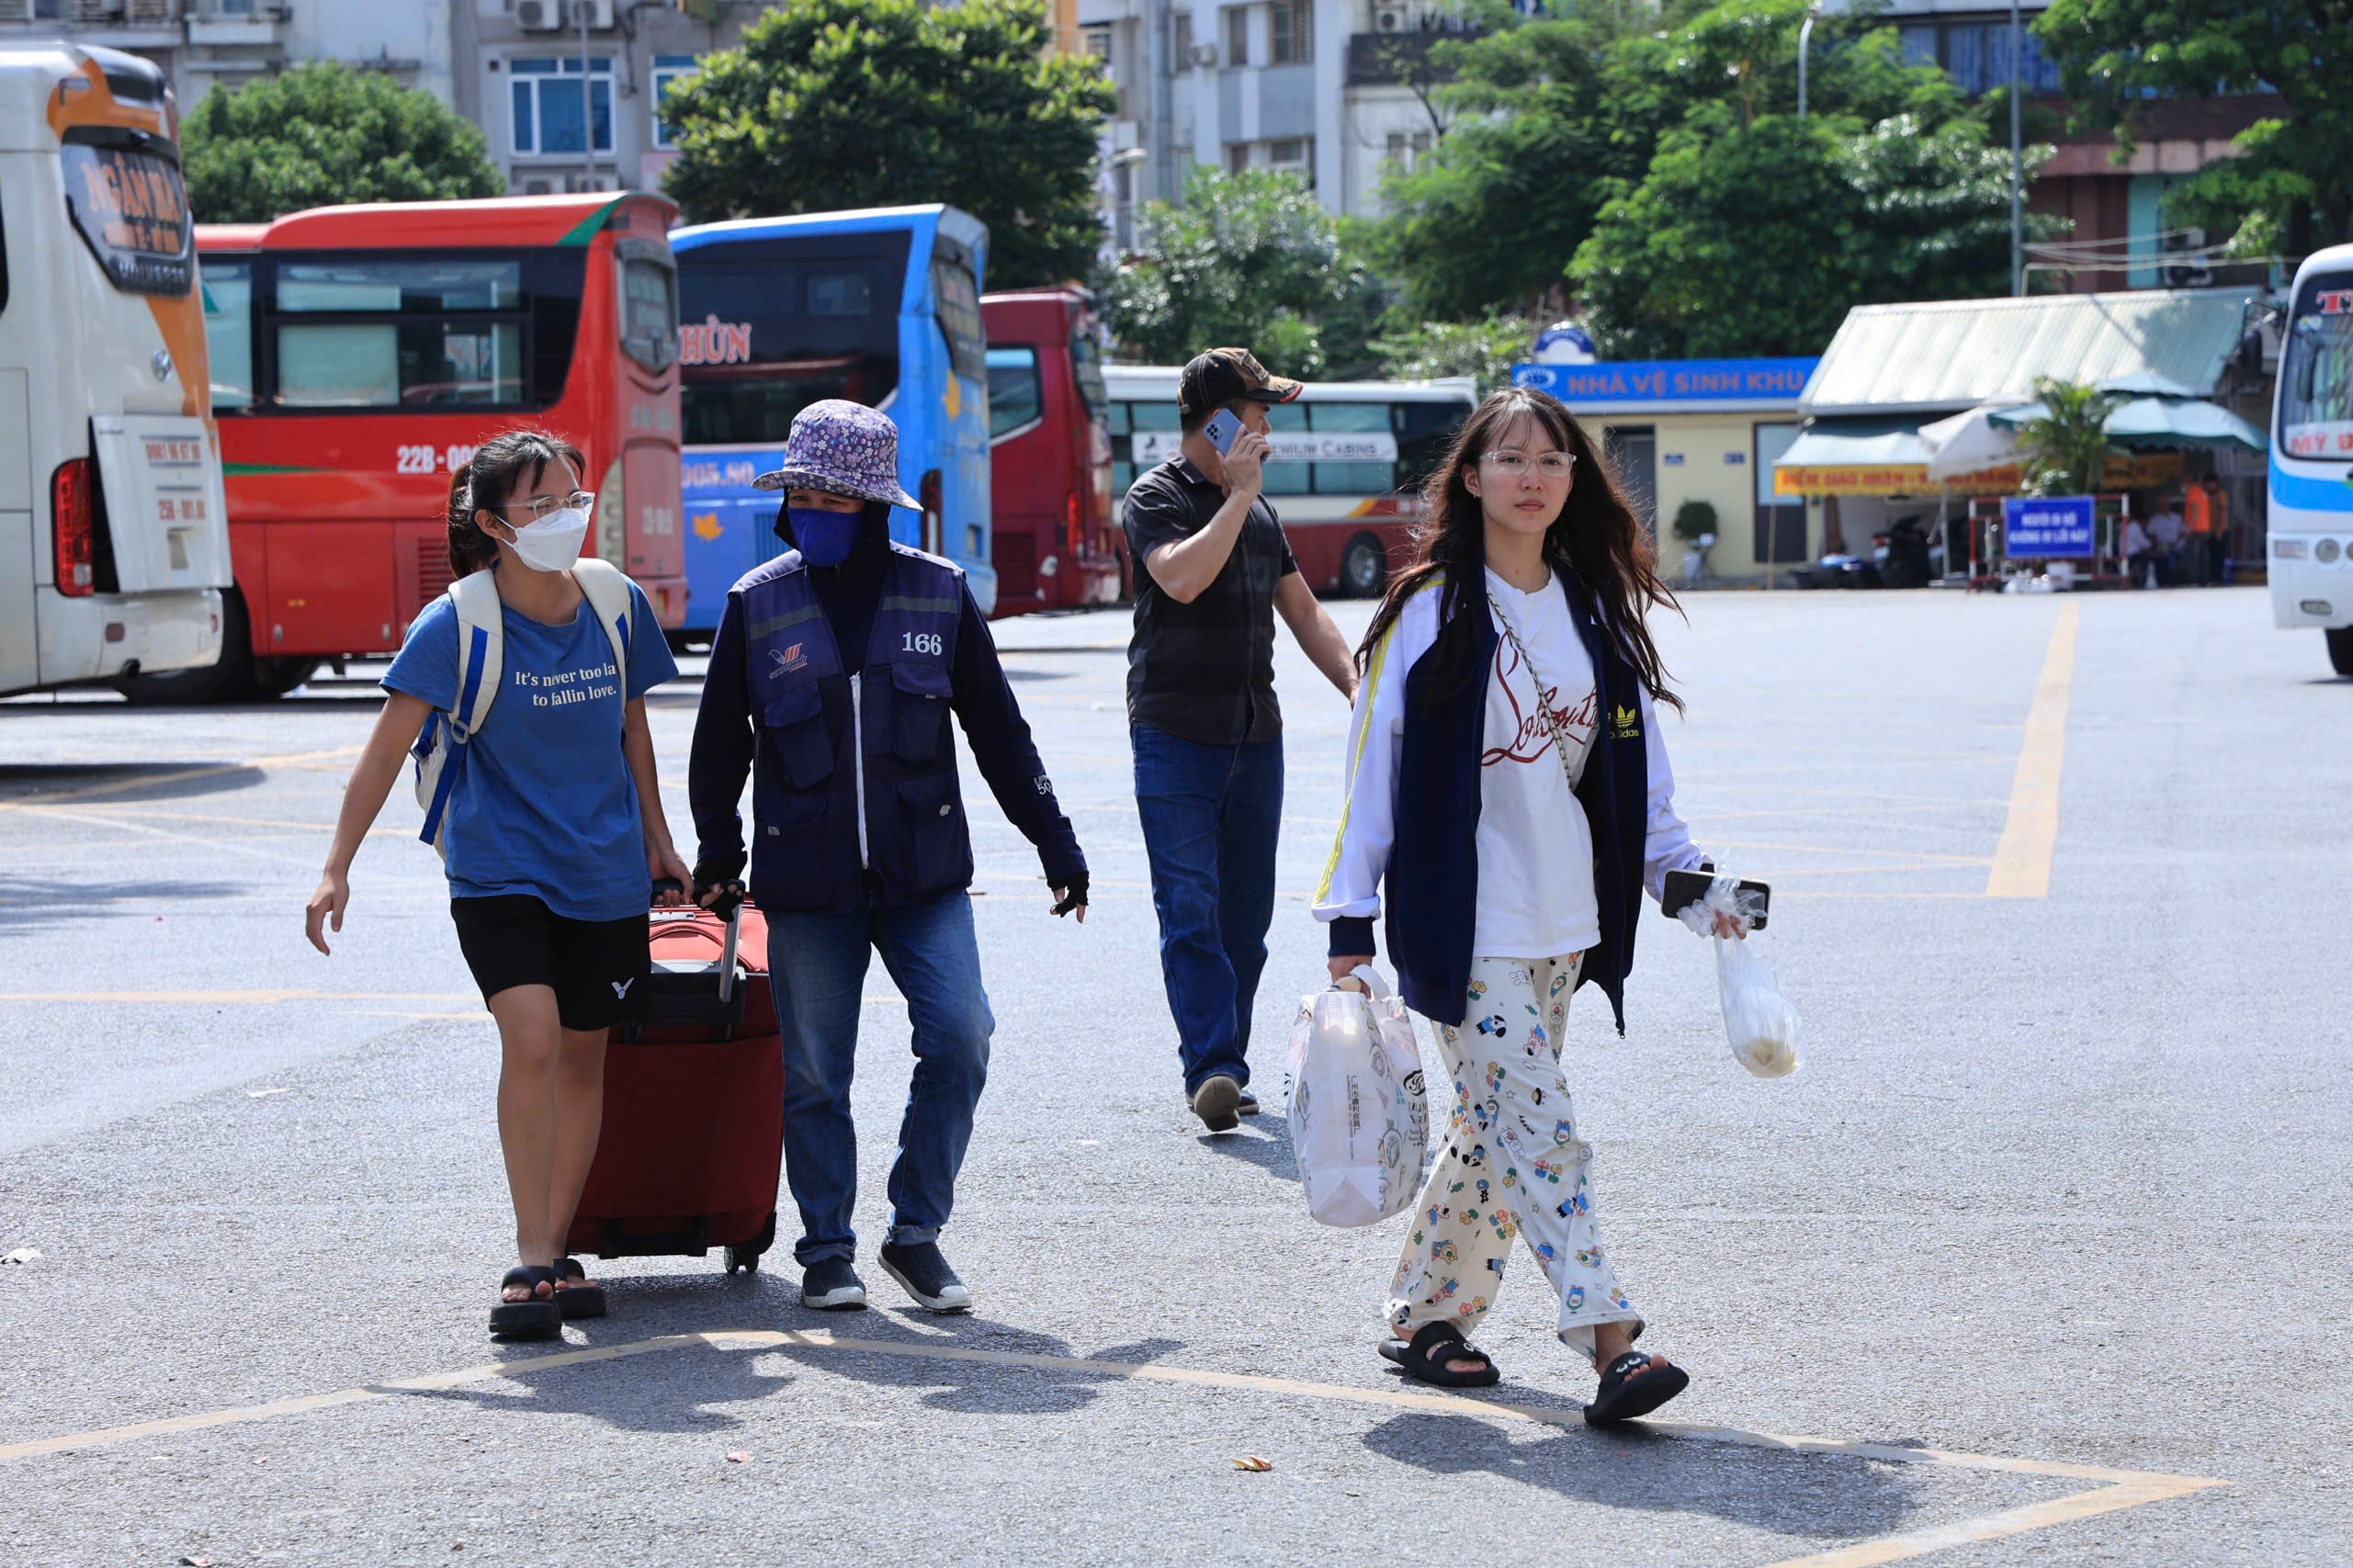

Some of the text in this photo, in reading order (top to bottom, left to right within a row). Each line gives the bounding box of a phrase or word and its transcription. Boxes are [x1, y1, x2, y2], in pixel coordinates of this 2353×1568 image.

[2316, 290, 2353, 315] T
[397, 445, 479, 474] 22B-00
[1270, 443, 1318, 457] EMIUM
[902, 631, 943, 656] 166
[515, 662, 617, 687] It's never too la
[532, 684, 617, 706] to fallin love.
